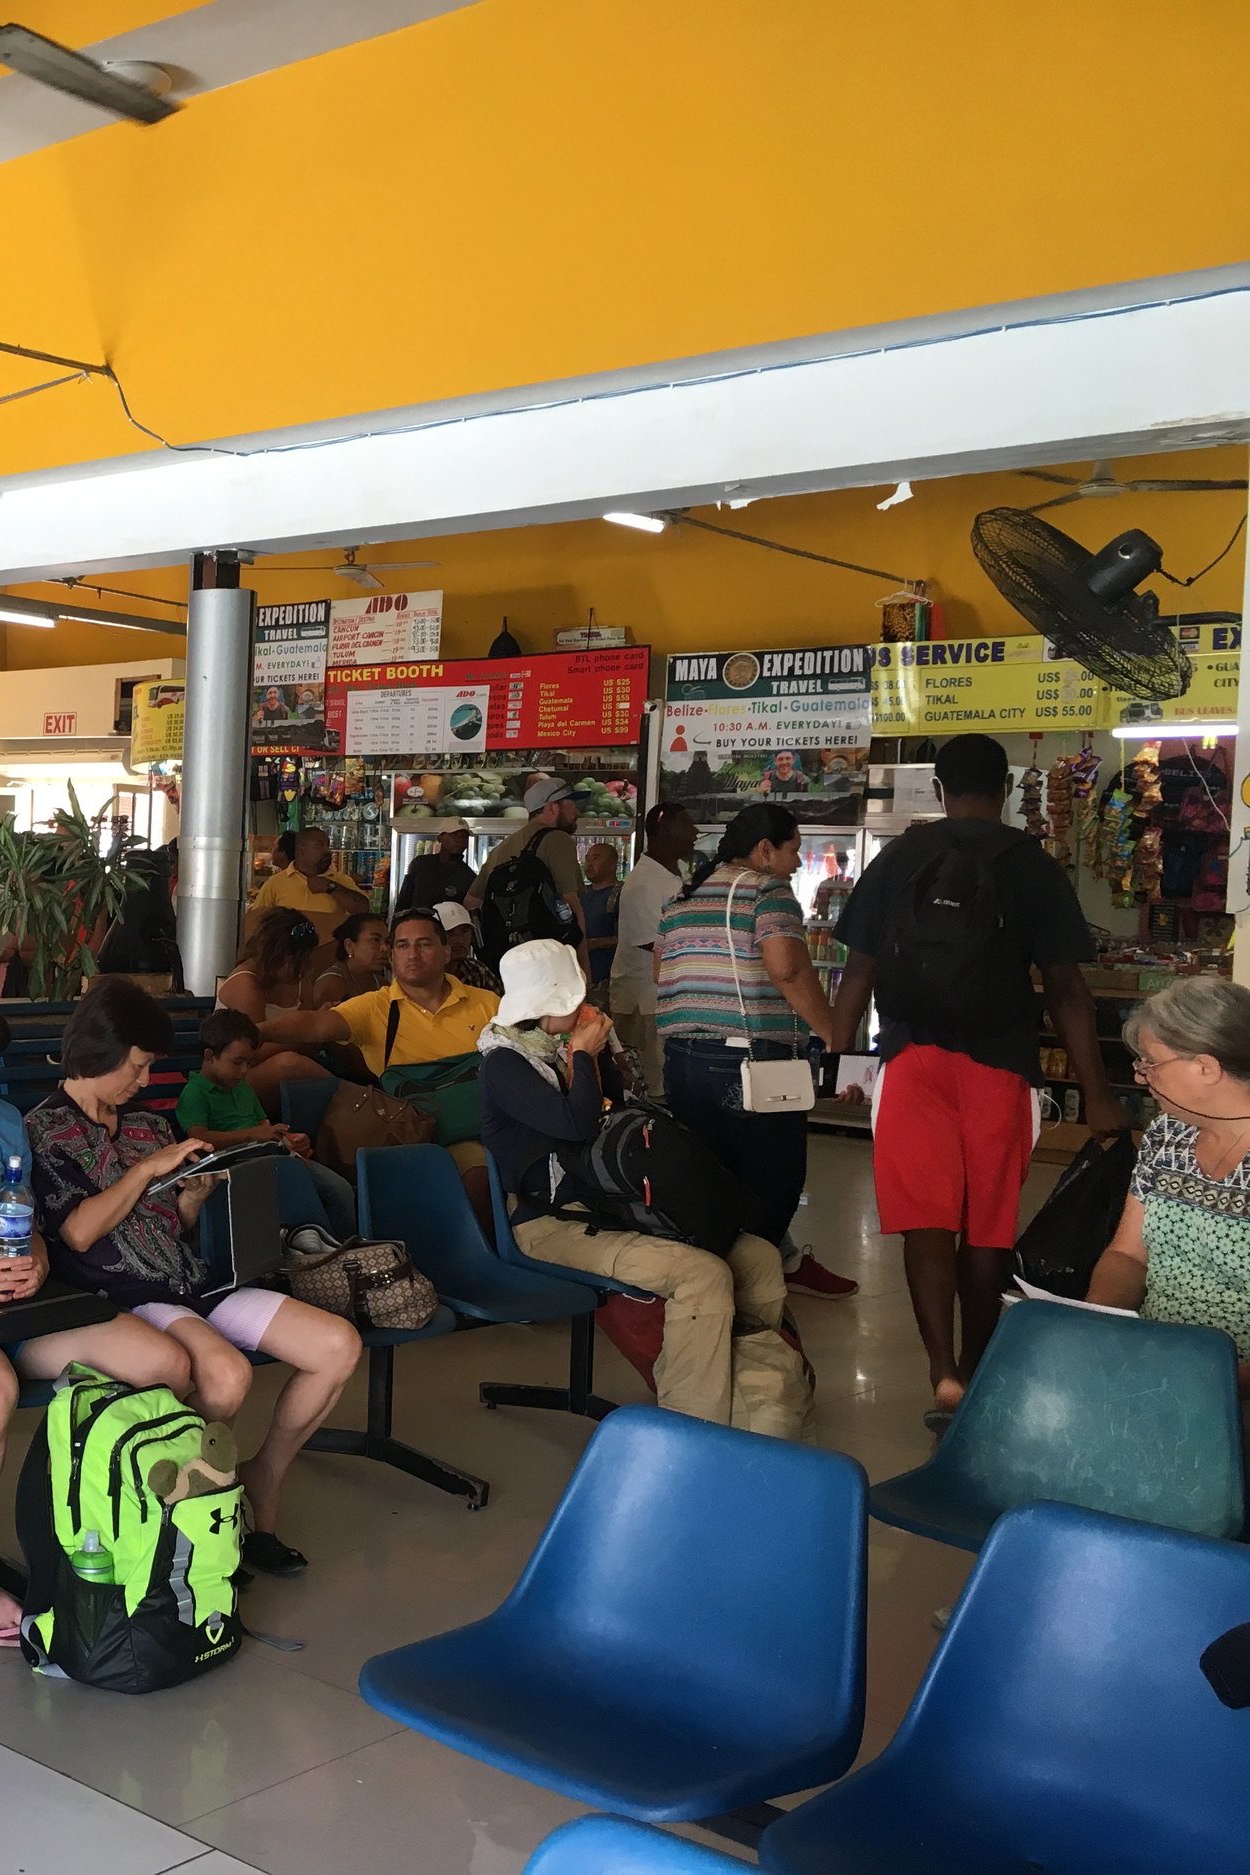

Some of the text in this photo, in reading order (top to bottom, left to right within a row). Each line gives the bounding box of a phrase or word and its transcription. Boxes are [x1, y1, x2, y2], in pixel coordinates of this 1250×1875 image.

[365, 594, 408, 614] ADO
[258, 603, 326, 627] EXPEDITION
[264, 628, 298, 641] TRAVEL
[254, 644, 272, 657] ikal
[901, 641, 1006, 666] SERVICE
[267, 659, 309, 669] EVERYDAY!
[594, 654, 621, 664] phone
[624, 652, 645, 661] card
[567, 661, 644, 674] Smart phone card
[675, 649, 864, 682] MAYA EXPEDITION
[267, 674, 295, 683] TICKETS
[298, 673, 320, 681] HERE!
[327, 664, 444, 683] TICKET BOOTH
[539, 682, 559, 690] Flores
[771, 679, 823, 695] TRAVEL
[925, 677, 973, 689] FLORES
[1037, 672, 1061, 683] US$
[381, 690, 412, 698] DEPARTURES
[603, 687, 613, 695] US
[925, 694, 959, 705] TIKAL
[1036, 688, 1060, 701] US$
[539, 697, 574, 706] Guatemala
[666, 697, 870, 717] Belize Flores Tikal Guatemala
[538, 705, 569, 713] Chetumal
[925, 705, 1092, 722] GUATEMALA CITY US$ 55.00
[46, 715, 75, 734] EXIT
[537, 721, 555, 729] Playa
[569, 719, 596, 727] Carmen
[713, 719, 842, 732] 10:30 A.M. EVERYDAY!
[537, 729, 561, 737] Mexico
[562, 729, 576, 738] City
[716, 736, 858, 748] BUY YOUR TICKETS HERE!
